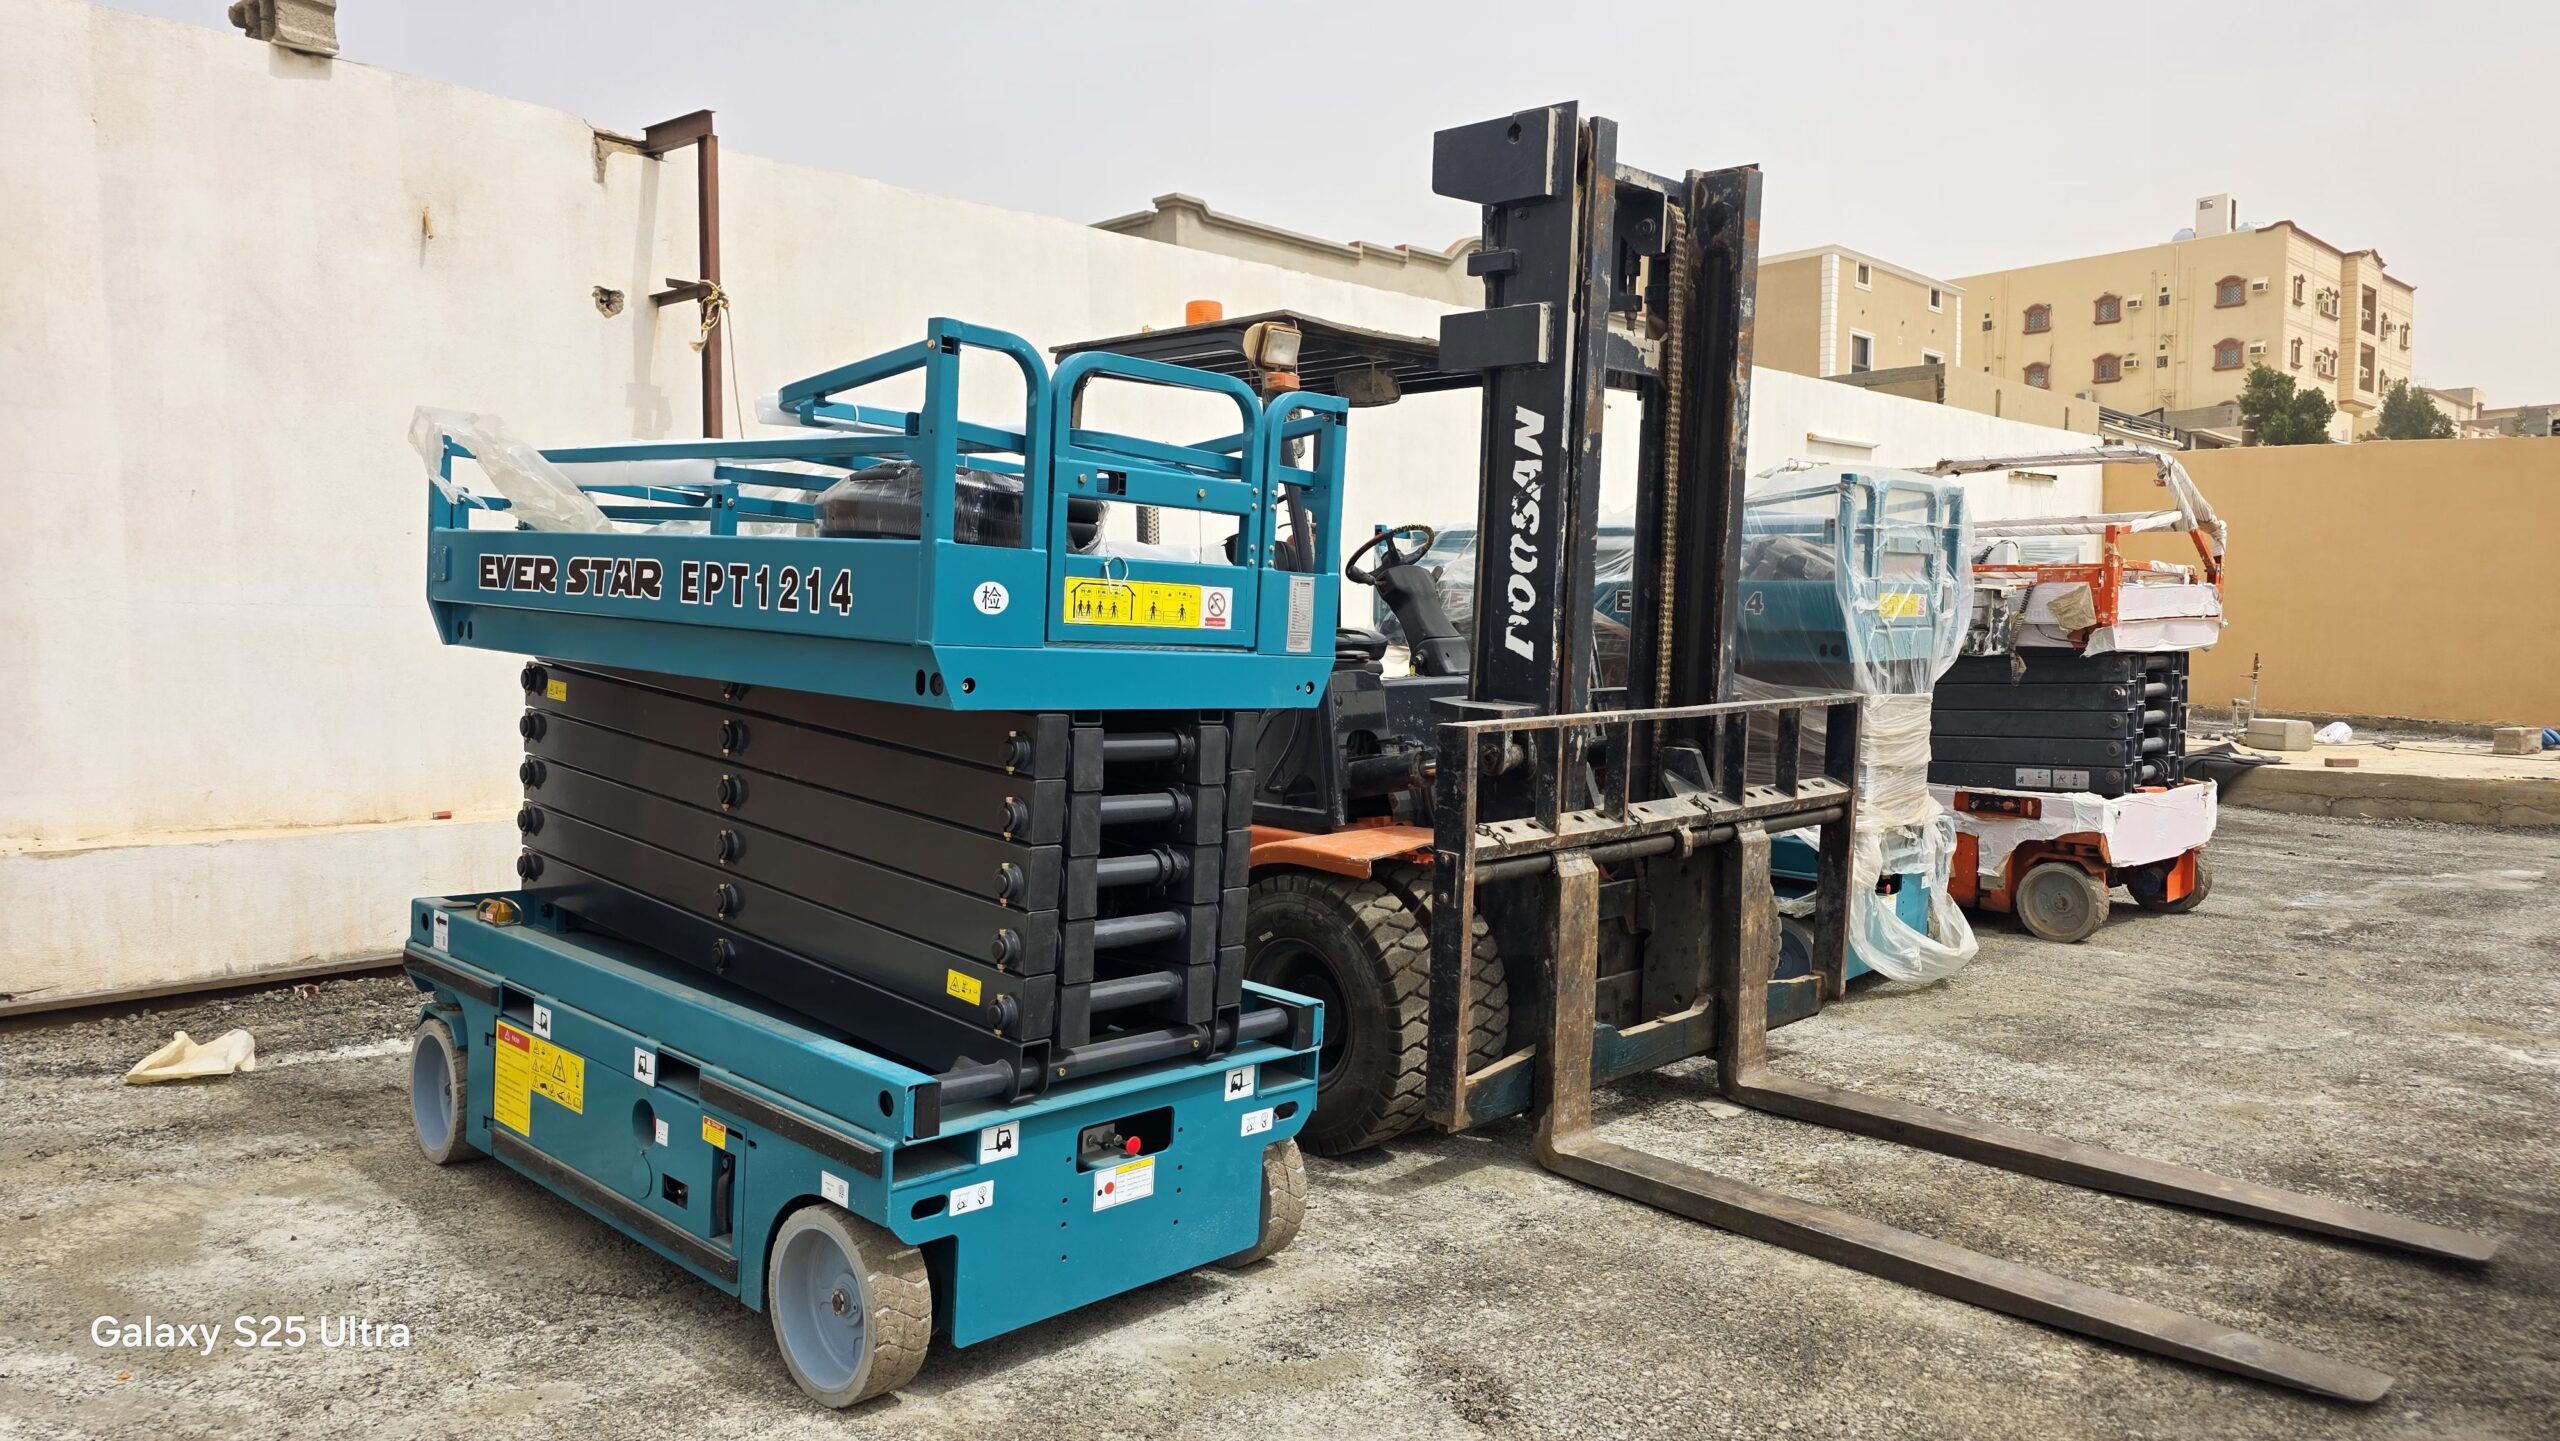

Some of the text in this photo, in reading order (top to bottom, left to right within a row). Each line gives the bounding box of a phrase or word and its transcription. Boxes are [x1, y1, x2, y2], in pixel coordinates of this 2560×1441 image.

[1504, 405, 1545, 662] DOOSAN
[479, 554, 853, 616] EVER STAR EPT1214
[981, 585, 1002, 610] 检
